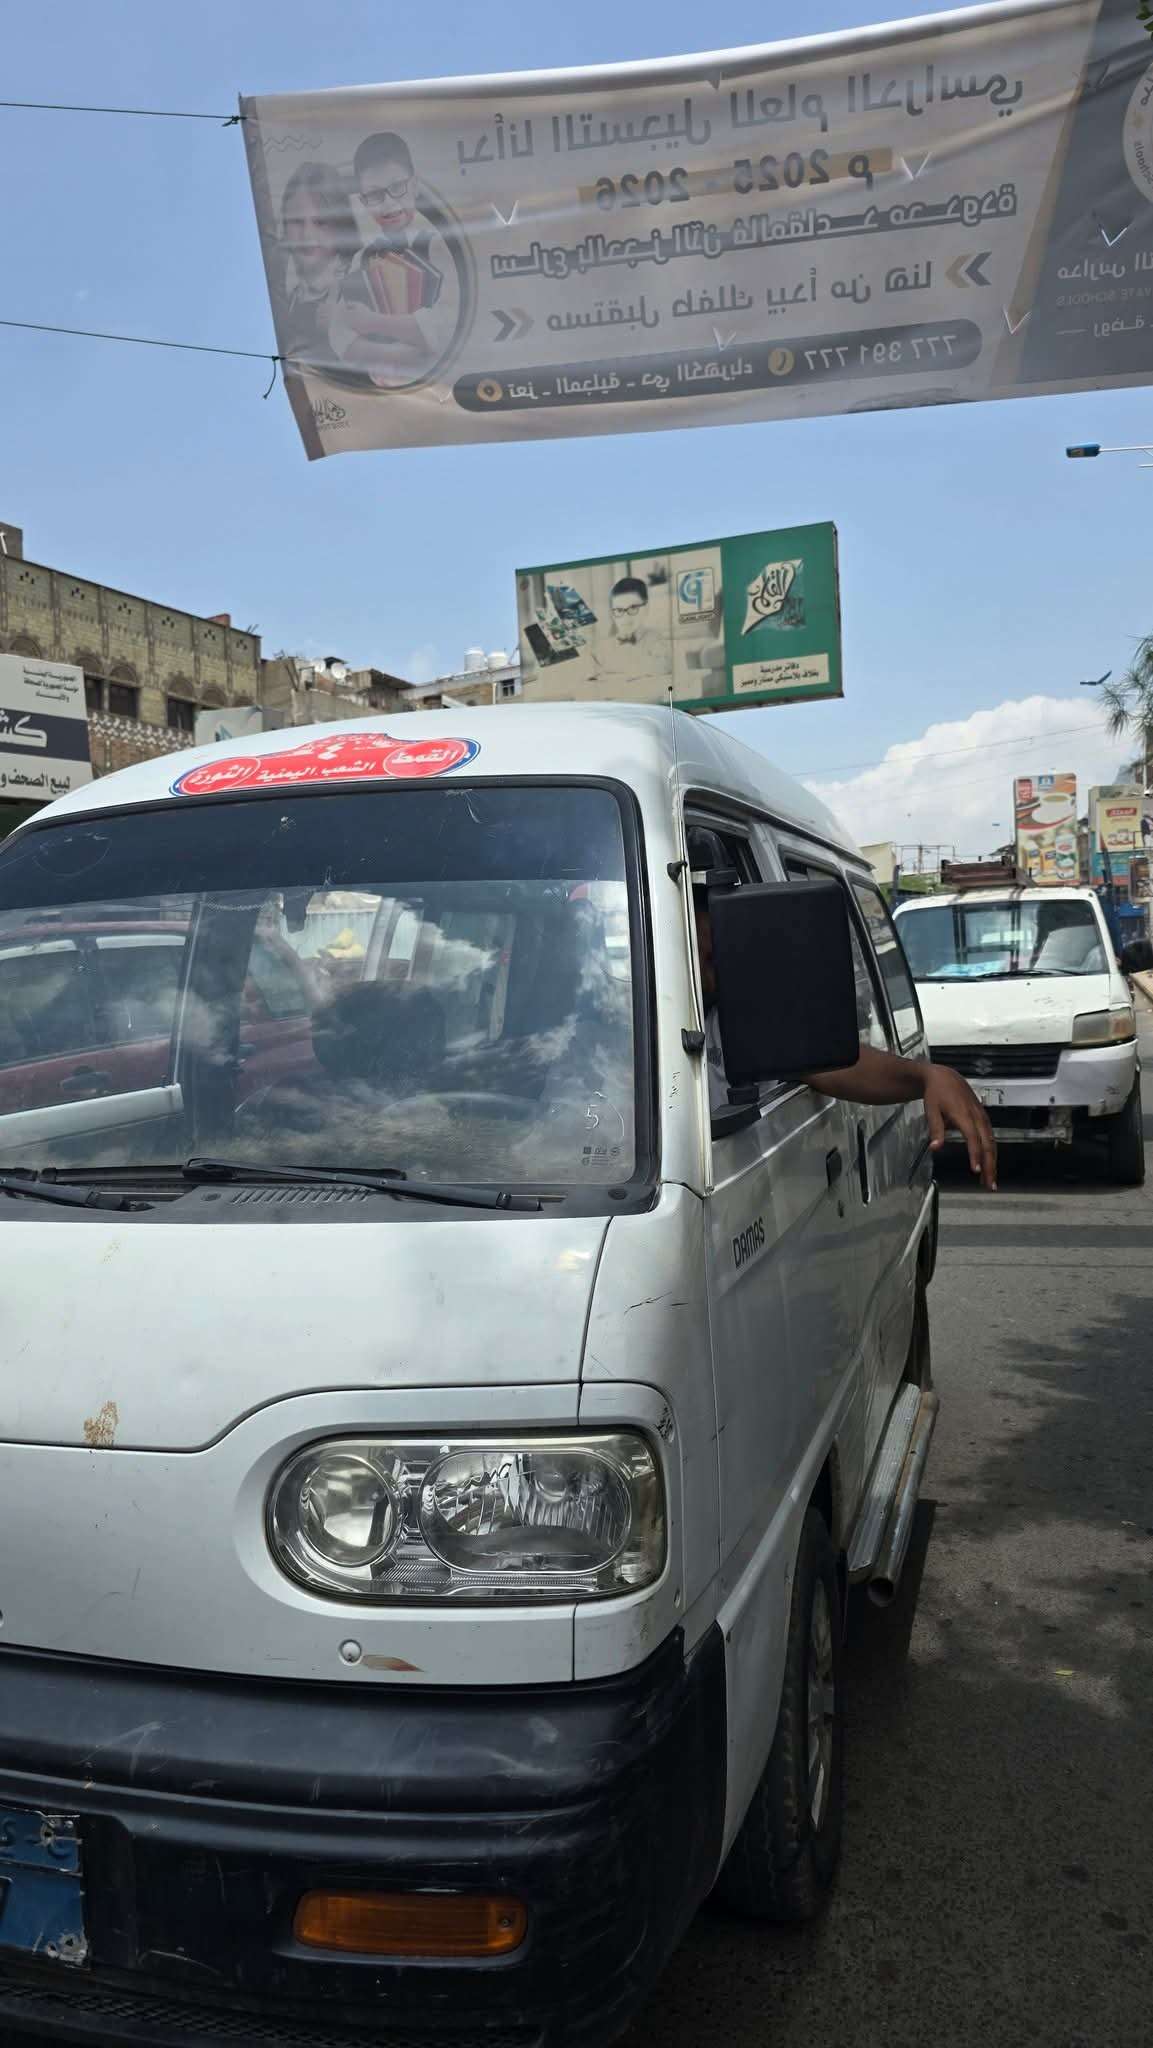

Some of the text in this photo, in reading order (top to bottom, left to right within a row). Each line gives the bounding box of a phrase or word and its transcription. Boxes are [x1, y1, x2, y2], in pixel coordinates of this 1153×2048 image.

[8, 768, 49, 788] الصحف
[189, 764, 253, 785] الثورة
[256, 760, 376, 782] الشعب اليمنية
[50, 776, 71, 794] لبيع
[732, 1216, 766, 1269] DAMAS
